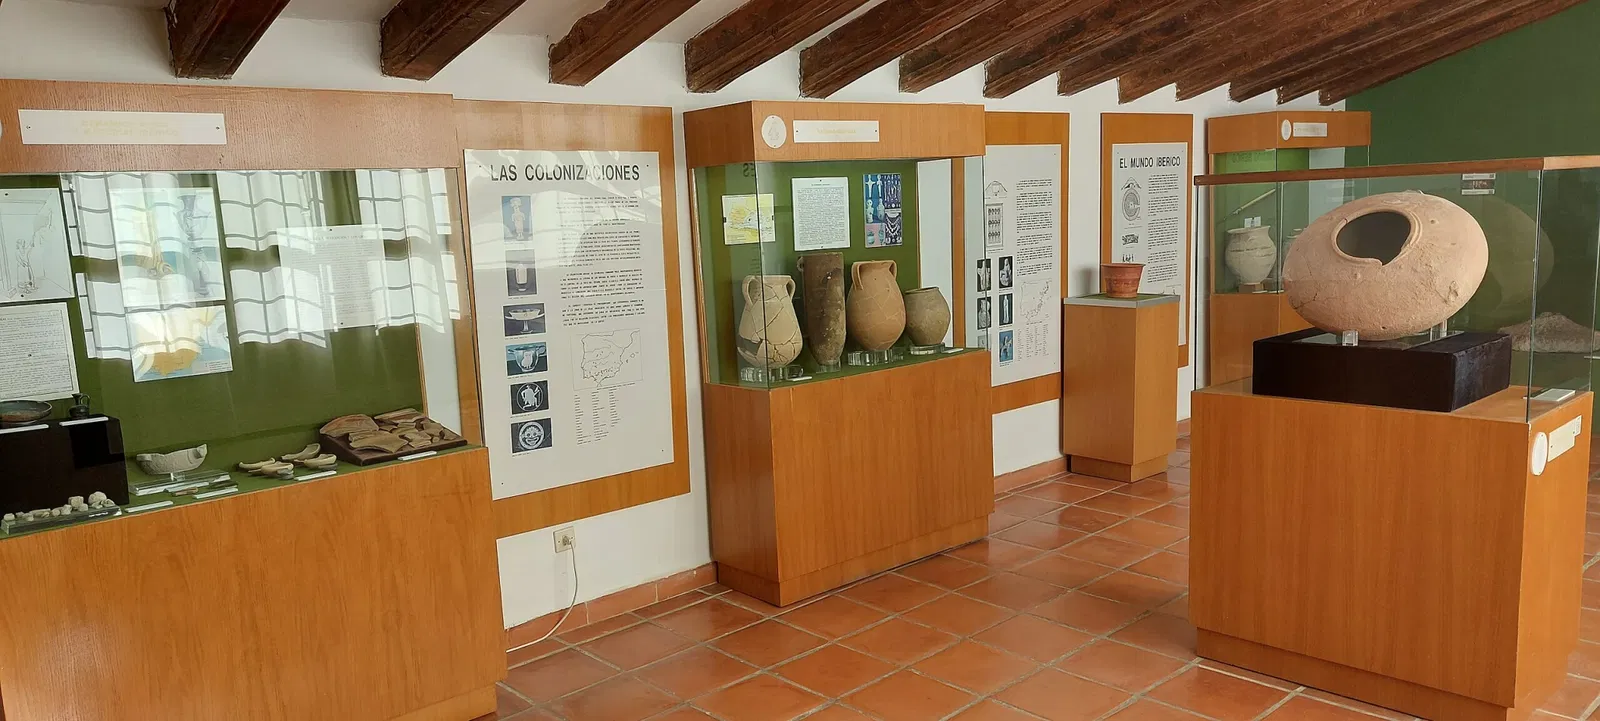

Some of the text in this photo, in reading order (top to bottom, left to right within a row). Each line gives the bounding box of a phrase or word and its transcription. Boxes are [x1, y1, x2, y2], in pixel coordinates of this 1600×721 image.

[1119, 155, 1181, 169] EL MUNDO IBERICO
[490, 164, 640, 181] LAS COLONIZACIONES
